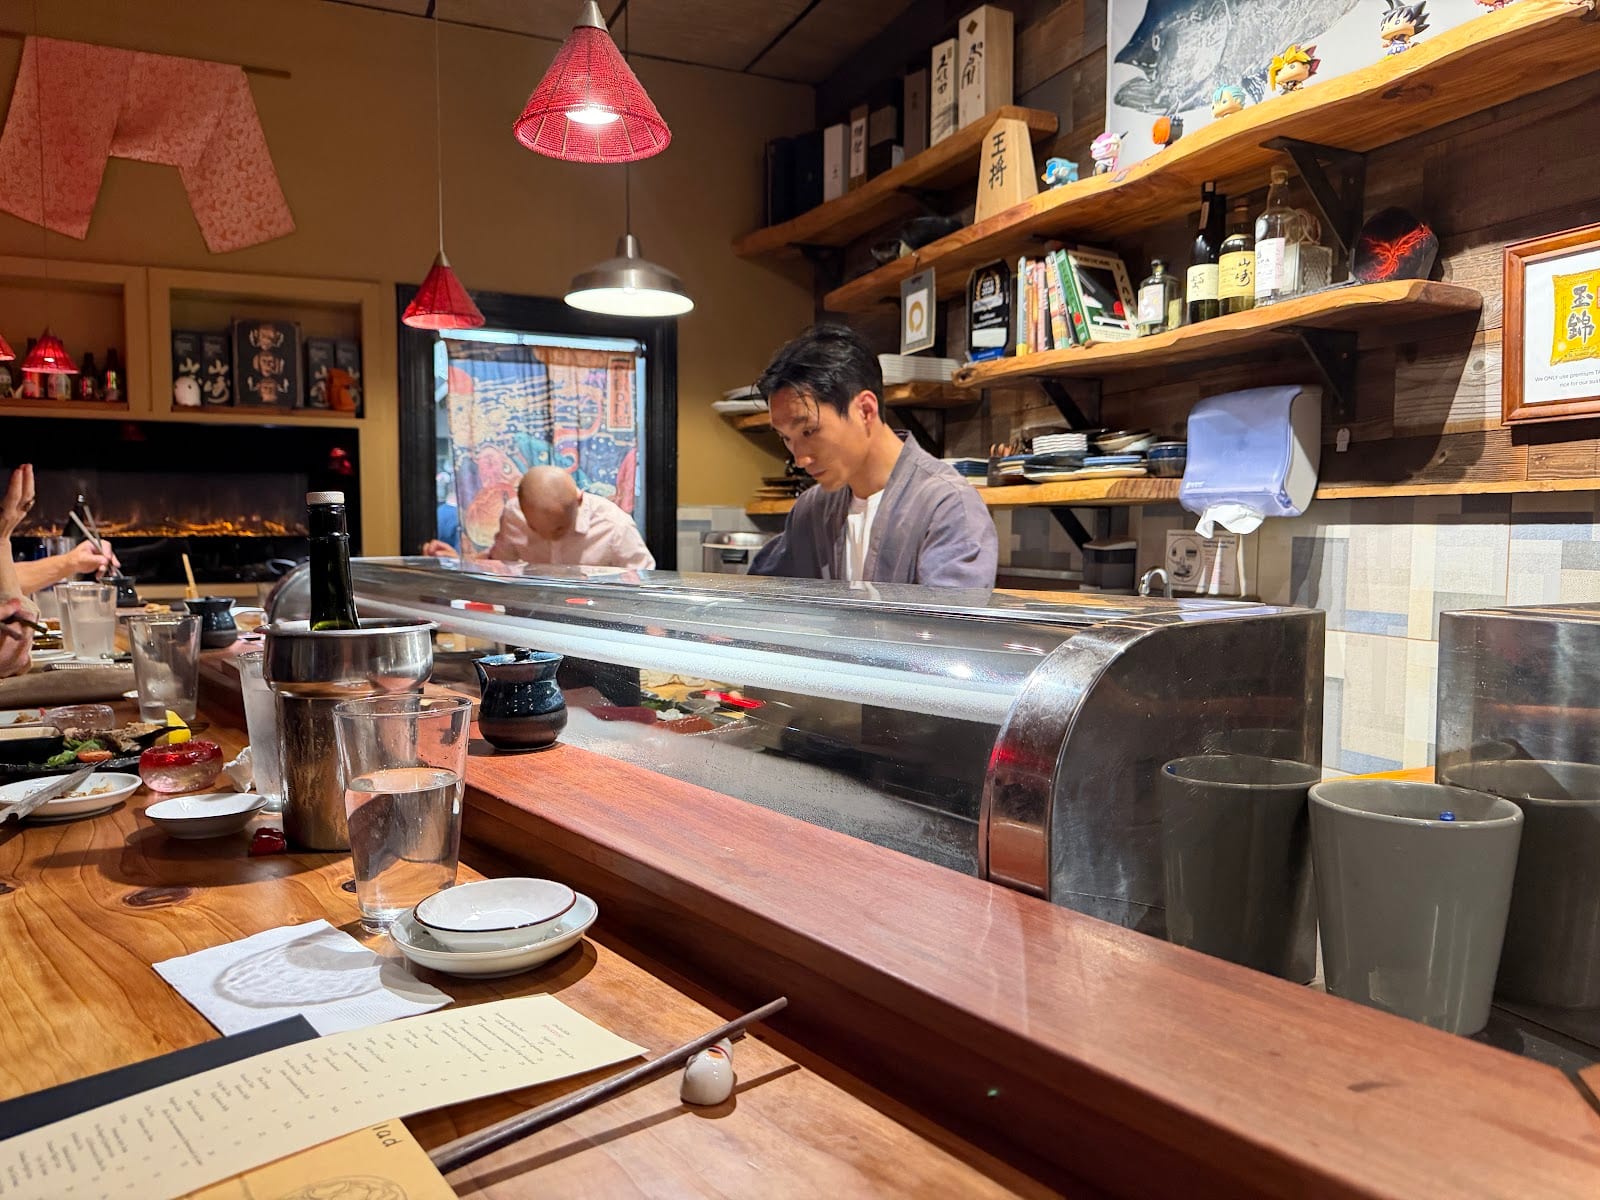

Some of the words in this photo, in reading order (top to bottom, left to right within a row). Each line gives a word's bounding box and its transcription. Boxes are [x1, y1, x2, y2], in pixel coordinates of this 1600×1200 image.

[988, 131, 1007, 190] 王将
[1567, 285, 1594, 343] 玉錦
[1544, 374, 1558, 382] ONLY
